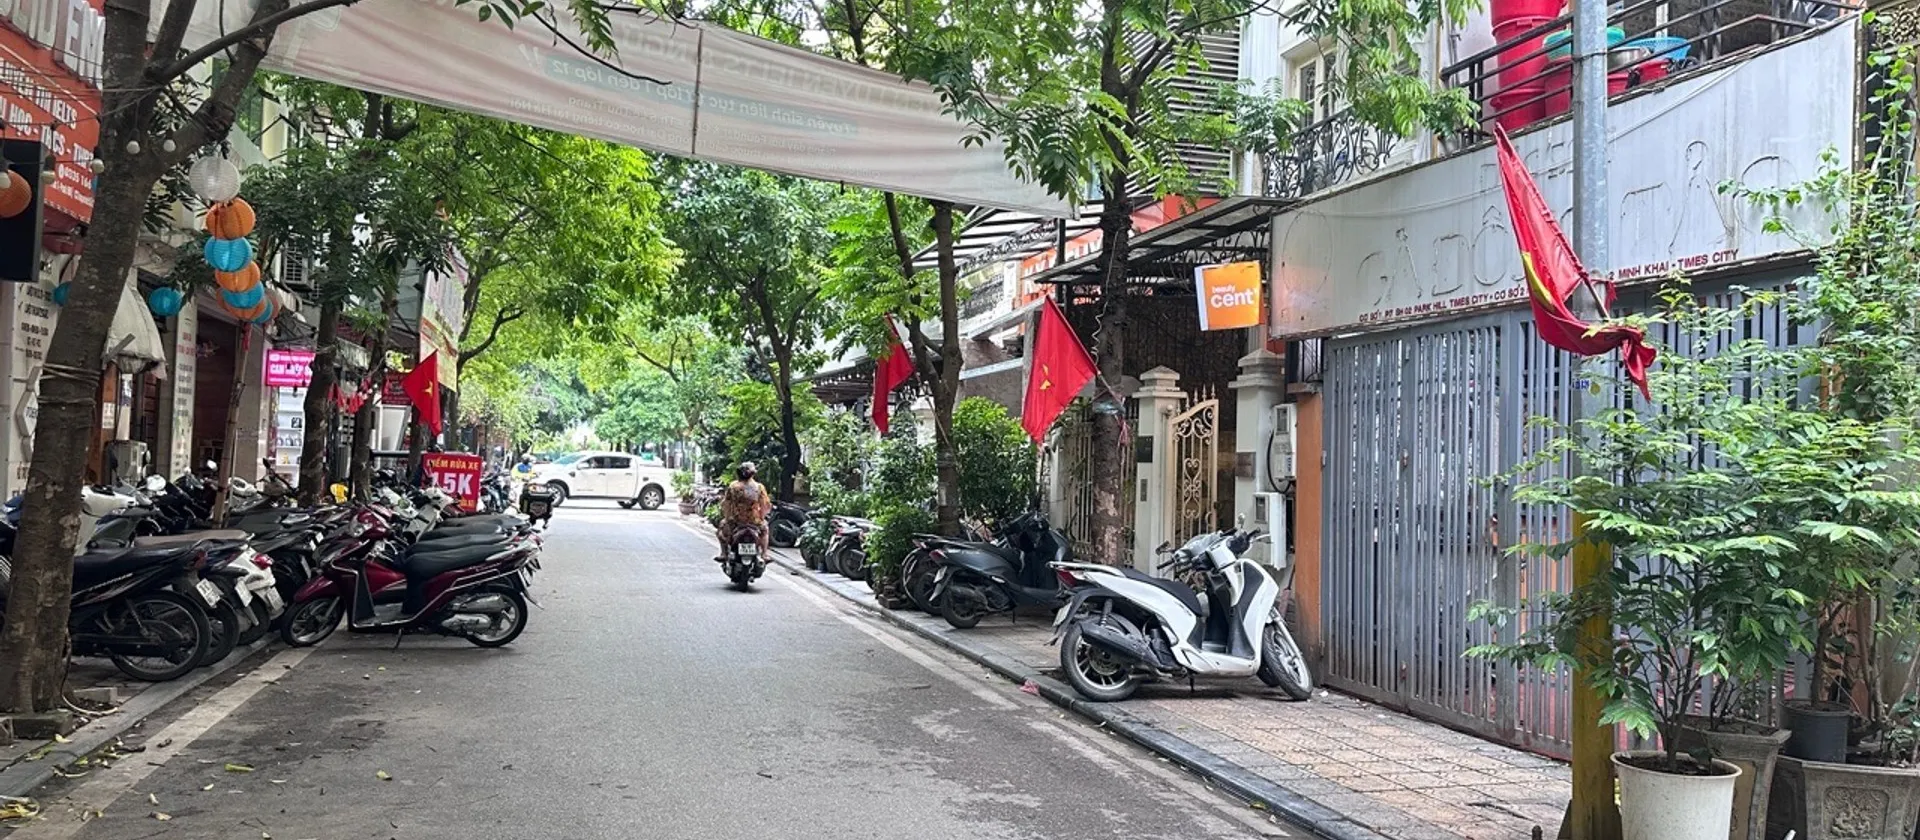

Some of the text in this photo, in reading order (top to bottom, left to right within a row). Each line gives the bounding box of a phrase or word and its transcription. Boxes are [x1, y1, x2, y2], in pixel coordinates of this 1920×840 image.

[1618, 265, 1641, 280] MINH
[1644, 261, 1669, 276] KHAI
[1677, 254, 1708, 270] TIMES
[1711, 249, 1739, 264] CITY
[1414, 303, 1432, 313] PARK
[1433, 301, 1447, 310] HILL
[1450, 295, 1470, 308] TIMES
[1471, 293, 1489, 305] CITY
[468, 462, 479, 471] XE
